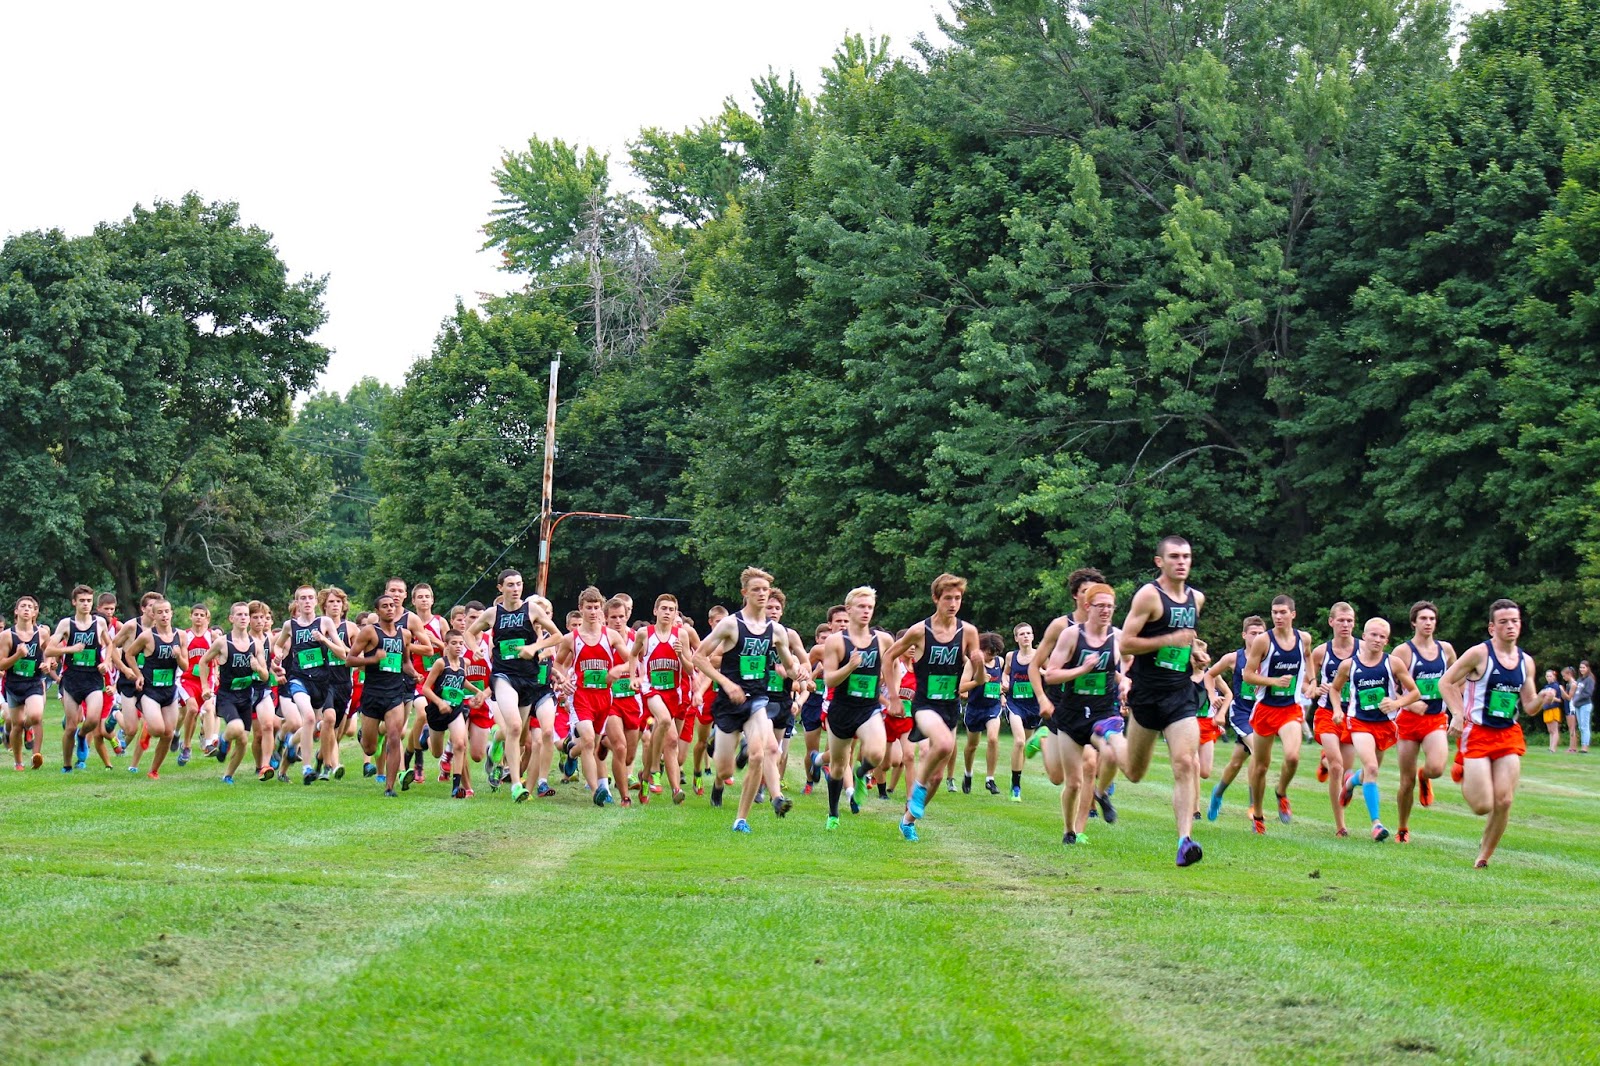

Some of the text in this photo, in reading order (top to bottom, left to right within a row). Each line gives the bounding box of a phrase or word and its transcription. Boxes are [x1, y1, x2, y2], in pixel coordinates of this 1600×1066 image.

[499, 613, 524, 629] FM
[1168, 607, 1196, 628] FM
[73, 632, 95, 646] FM
[383, 638, 402, 653] FM
[740, 637, 770, 656] FM
[232, 653, 251, 668] FM
[388, 657, 395, 665] 61
[769, 650, 783, 666] M
[928, 645, 959, 665] FM
[749, 662, 759, 671] 64
[440, 674, 464, 689] FM
[659, 675, 668, 683] 18
[938, 681, 949, 690] 74
